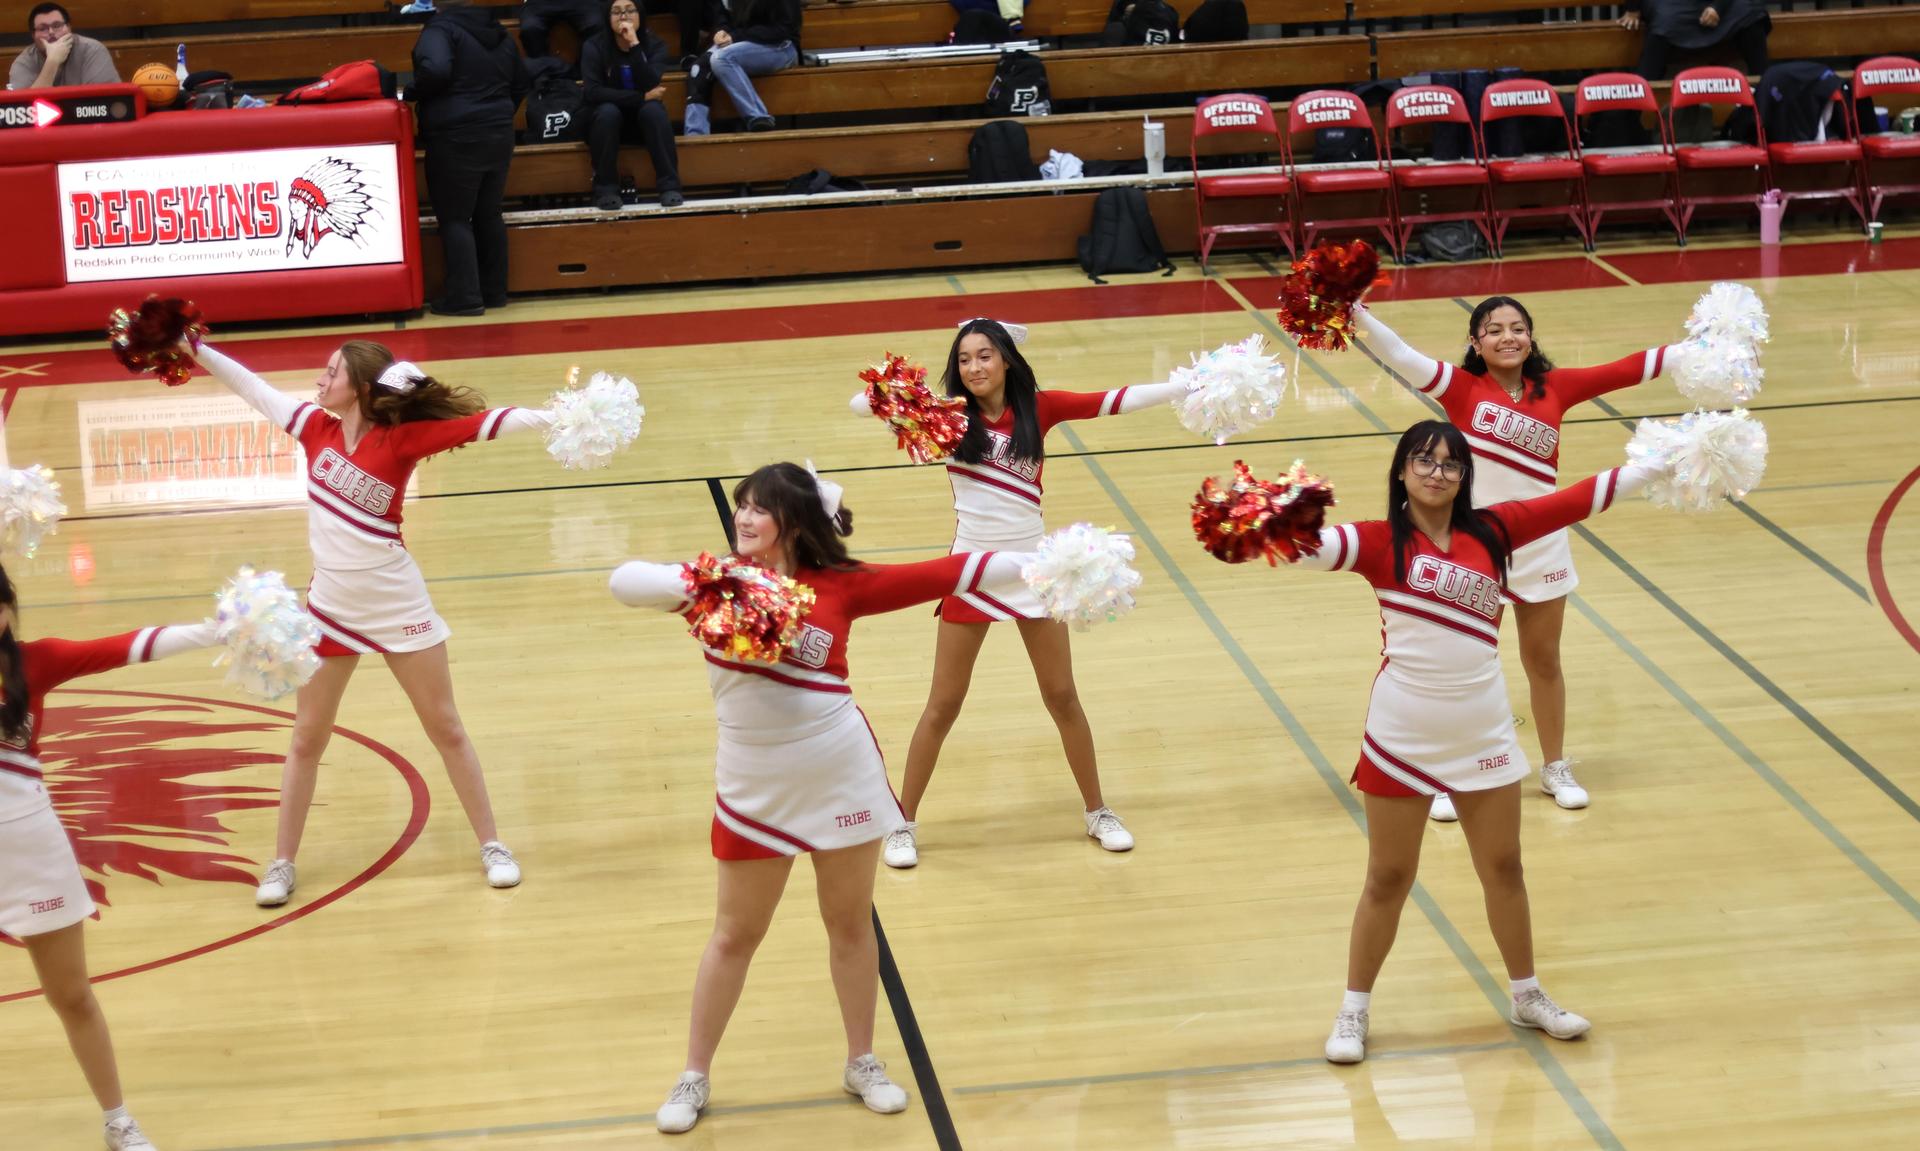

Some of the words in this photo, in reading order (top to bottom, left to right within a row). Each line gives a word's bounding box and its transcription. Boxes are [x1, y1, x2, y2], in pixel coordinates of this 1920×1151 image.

[1861, 68, 1920, 86] CHOWCHILLA
[1583, 83, 1645, 101] CHOWCHILLA
[1679, 78, 1741, 95] CHOWCHILLA
[1297, 97, 1357, 116] OFFICIAL
[1396, 91, 1455, 110] OFFICIAL
[1489, 89, 1551, 107] CHOWCHILLA
[76, 105, 107, 118] BONUS
[1203, 101, 1264, 119] OFFICIAL
[1305, 109, 1351, 124] SCORER
[1404, 103, 1449, 118] SCORER
[1210, 114, 1257, 128] SCORER
[84, 168, 124, 182] FCA
[69, 180, 282, 250] REDSKINS
[74, 257, 127, 269] Redskin
[131, 253, 165, 265] Pride
[169, 250, 243, 262] Community
[247, 246, 280, 258] Wide
[1472, 401, 1558, 459] CUHS
[312, 447, 396, 516] CUHS
[1543, 567, 1568, 583] TRIBE
[1407, 554, 1500, 619] CUHS
[402, 620, 433, 636] TRIBE
[1477, 753, 1510, 771] TRIBE
[835, 809, 872, 828] TRIBE
[29, 896, 65, 914] TRIBE
